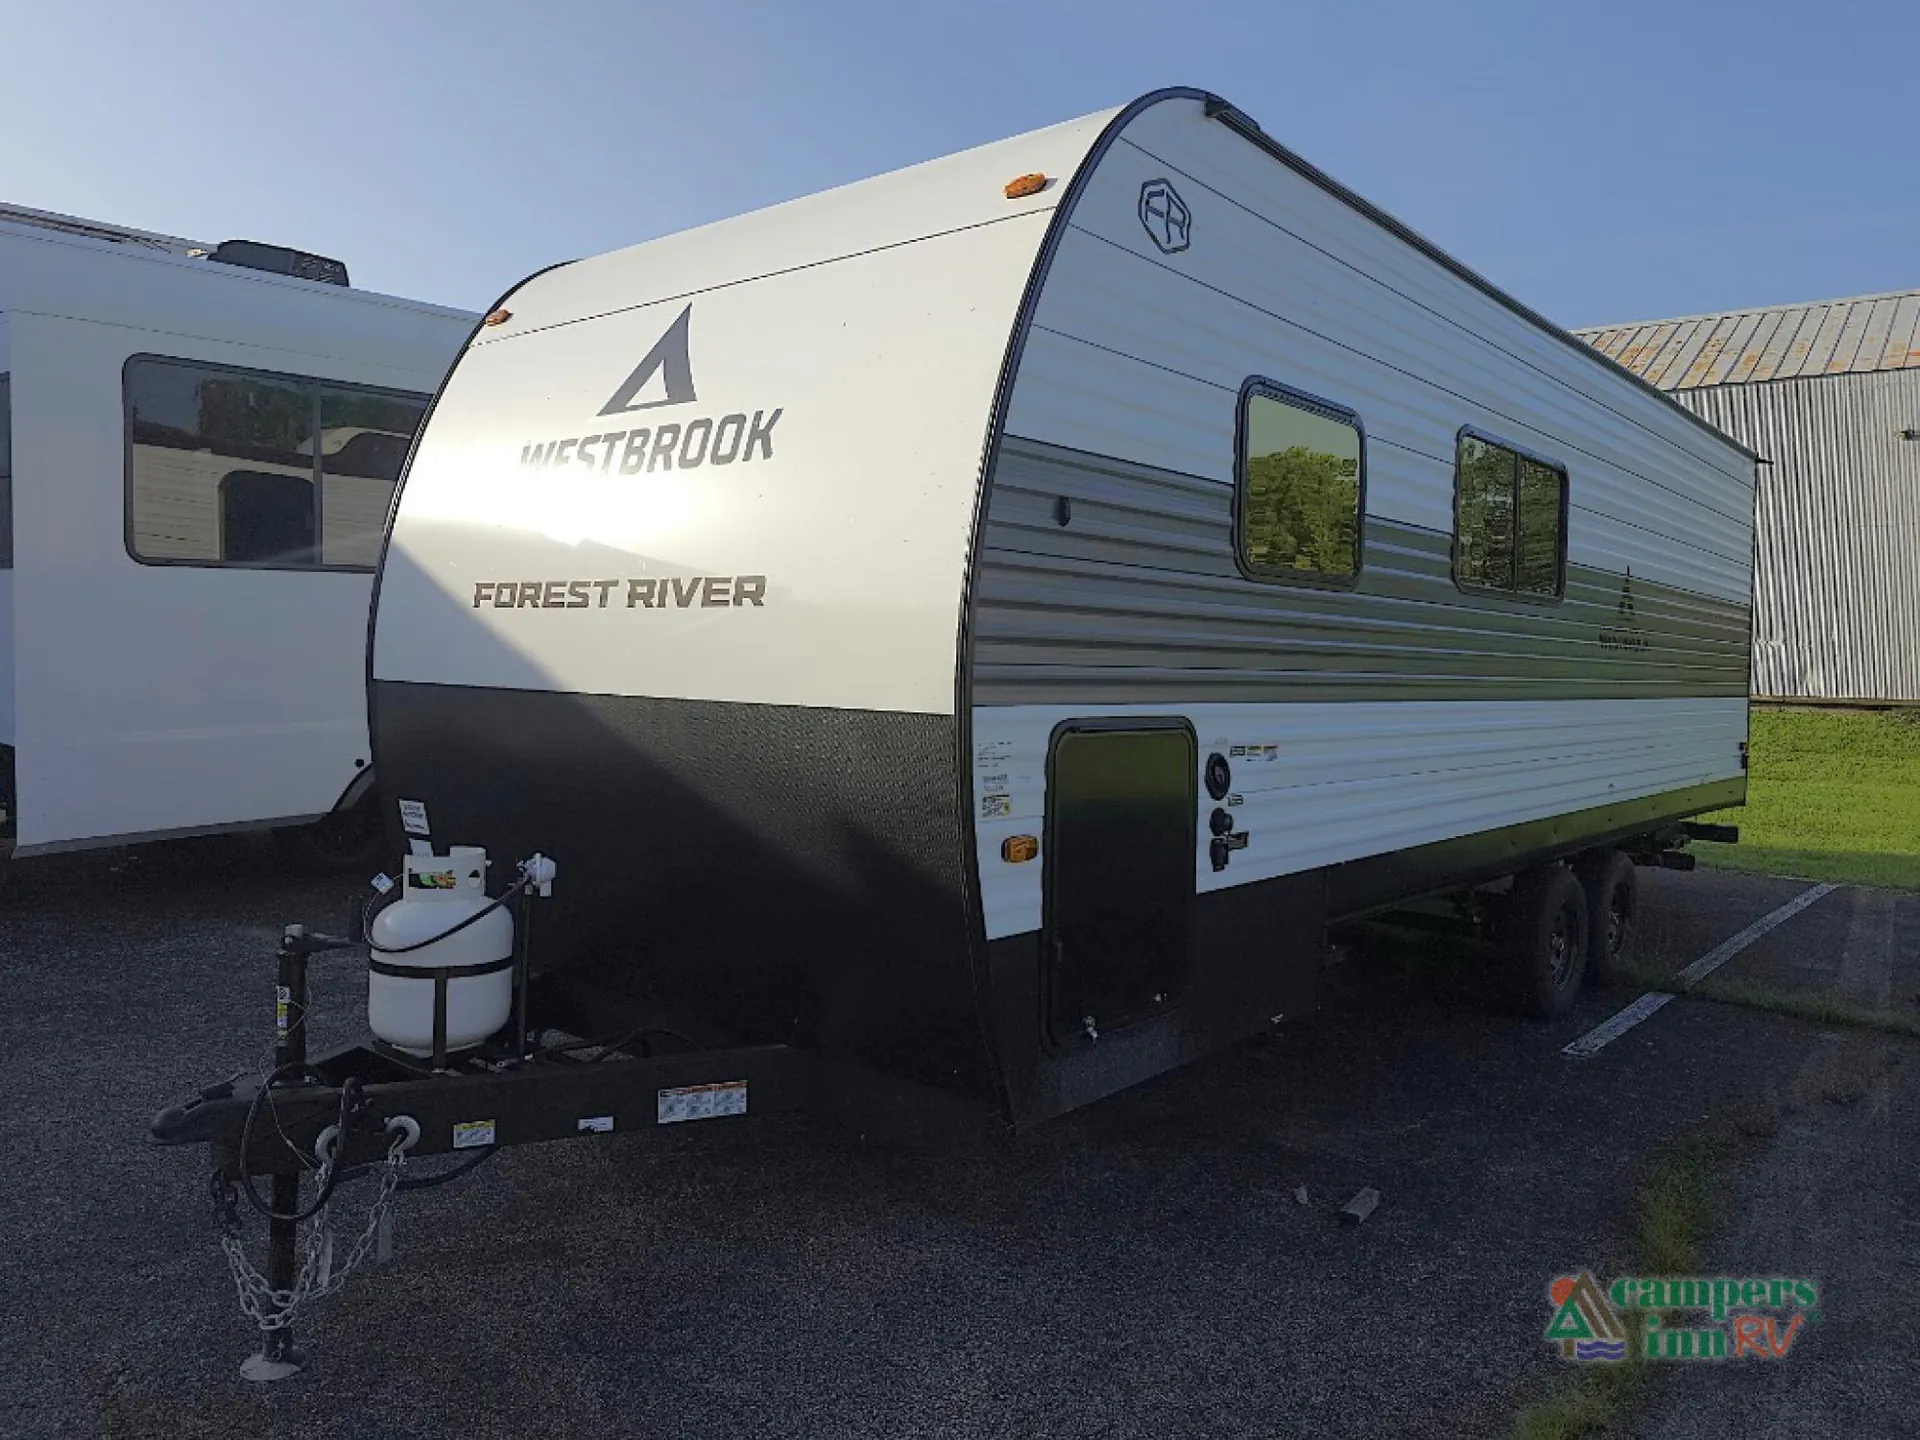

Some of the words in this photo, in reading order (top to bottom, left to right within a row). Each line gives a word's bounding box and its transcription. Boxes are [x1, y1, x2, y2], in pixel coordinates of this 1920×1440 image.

[520, 406, 784, 475] WESTBROOK
[473, 579, 619, 608] FOREST
[626, 575, 767, 608] RIVER
